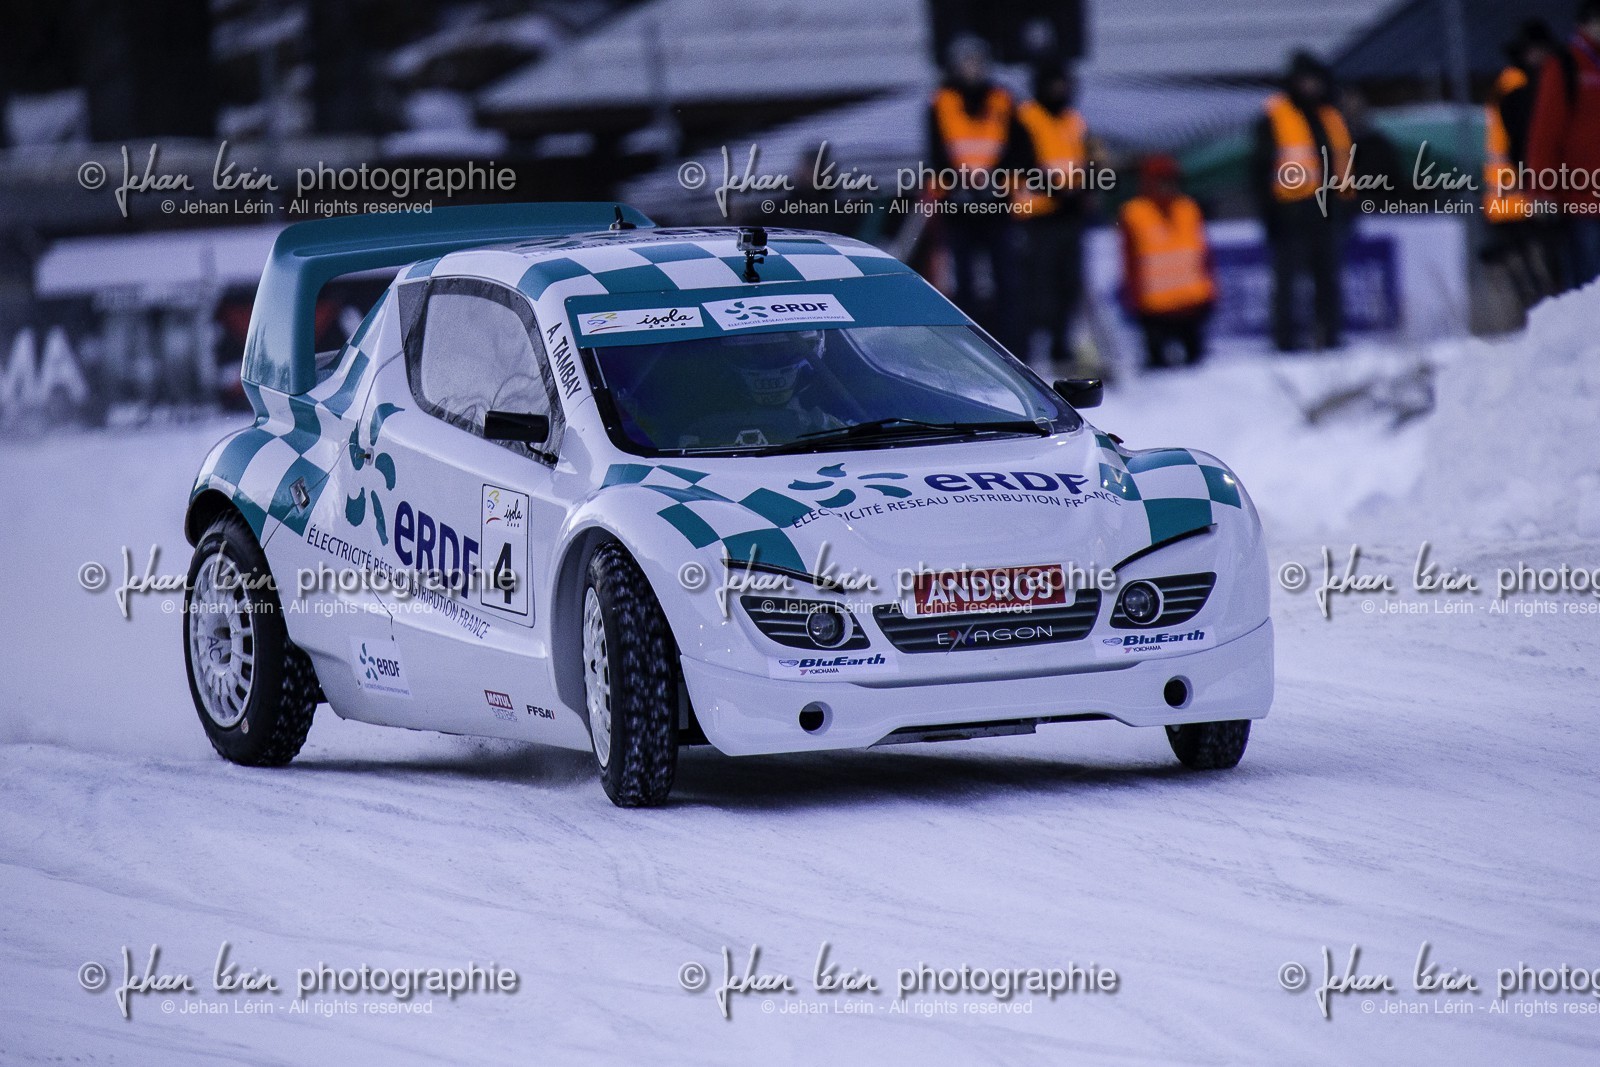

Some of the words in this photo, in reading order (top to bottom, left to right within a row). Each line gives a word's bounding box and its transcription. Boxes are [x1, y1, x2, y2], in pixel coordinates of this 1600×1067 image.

[637, 308, 694, 325] isola
[771, 302, 829, 313] eRDF
[547, 322, 562, 344] A.
[553, 336, 582, 400] TAMBAY
[924, 471, 1089, 495] eRDF
[953, 493, 1061, 507] DISTRIBUTION
[1064, 491, 1122, 508] FRANCE
[394, 501, 479, 599] eRDF
[307, 524, 372, 571] ÉLECTRICITÉ
[459, 608, 490, 640] FRANCE
[493, 542, 515, 605] 4
[926, 571, 1054, 607] ANDROS
[937, 624, 1053, 654] EXAGON
[1123, 630, 1205, 646] BluEarth
[799, 654, 886, 668] BluEarth
[809, 667, 839, 675] YOKOHAMA
[486, 692, 512, 708] MOTUL
